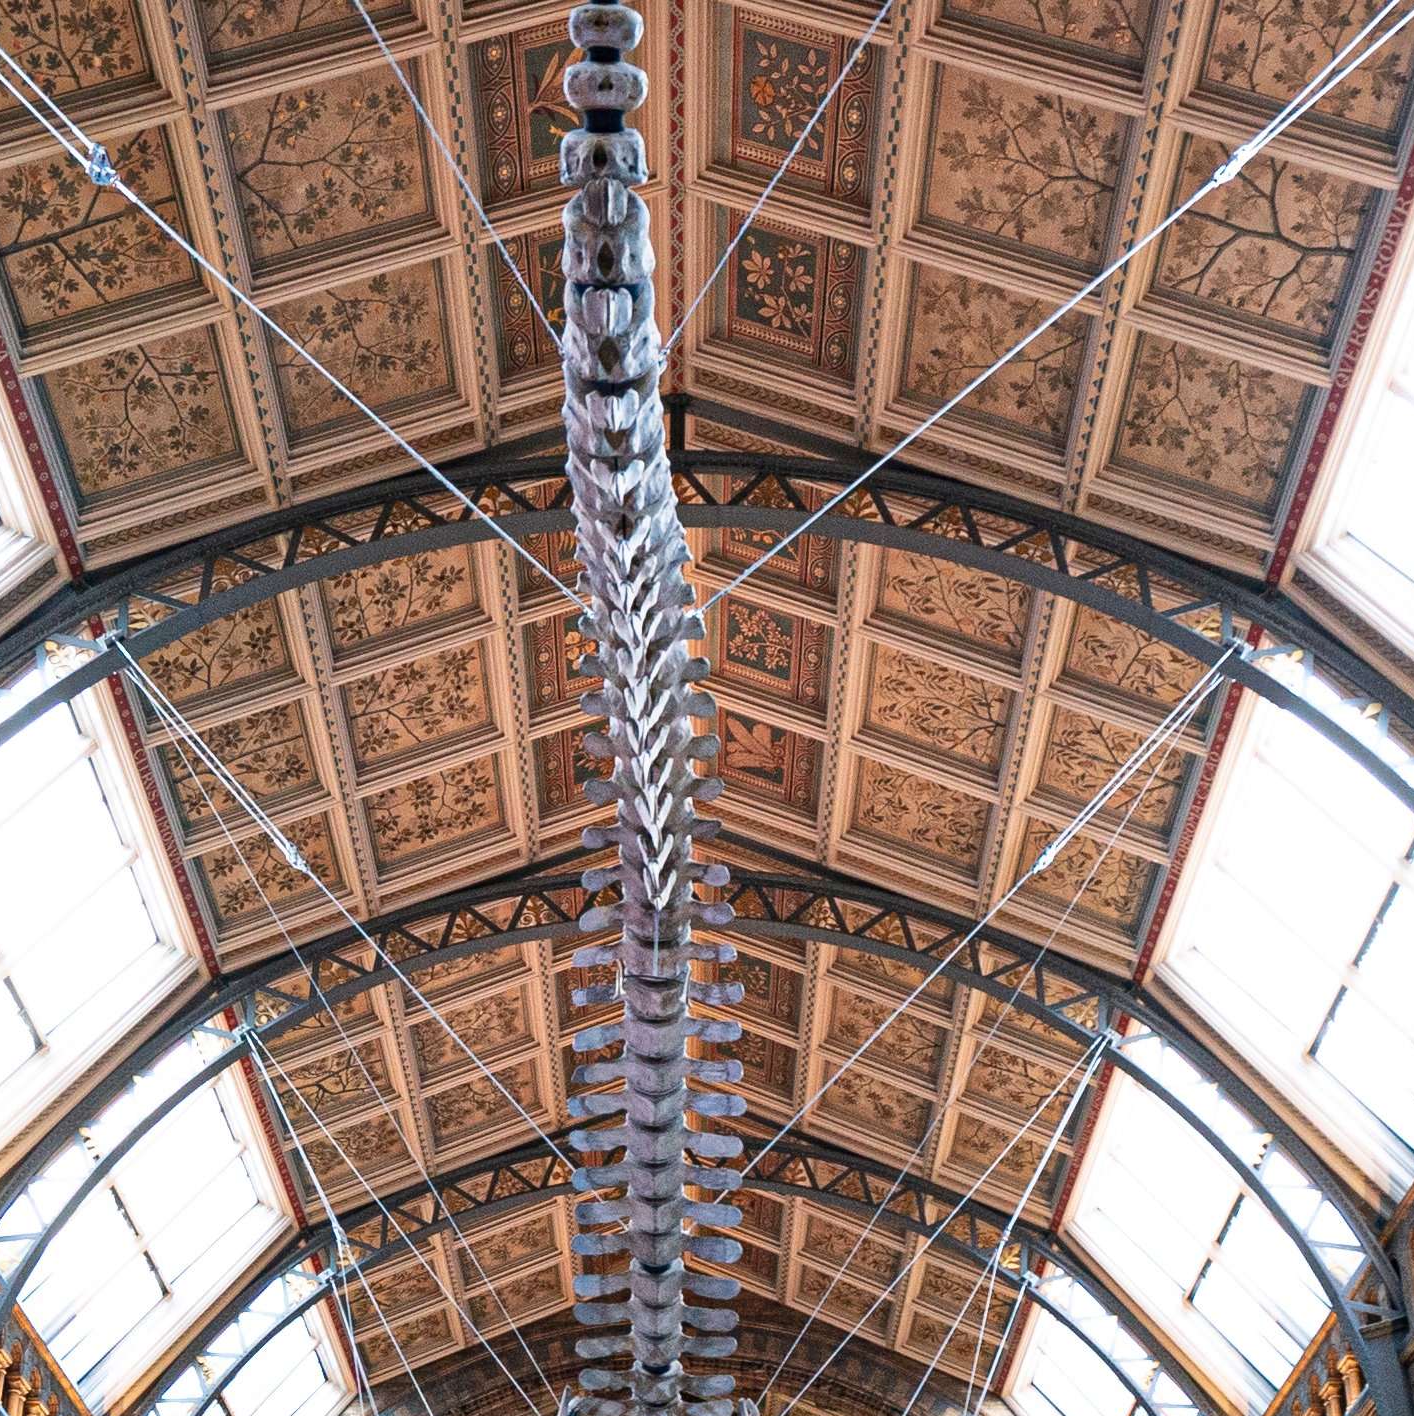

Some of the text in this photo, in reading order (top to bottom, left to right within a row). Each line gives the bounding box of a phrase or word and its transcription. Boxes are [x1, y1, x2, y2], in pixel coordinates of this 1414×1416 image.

[1334, 195, 1412, 390] QVERCVS ROBVR
[133, 748, 184, 869] CITRVS LIMONVM
[1168, 750, 1221, 881] THEOBROMA CACAO
